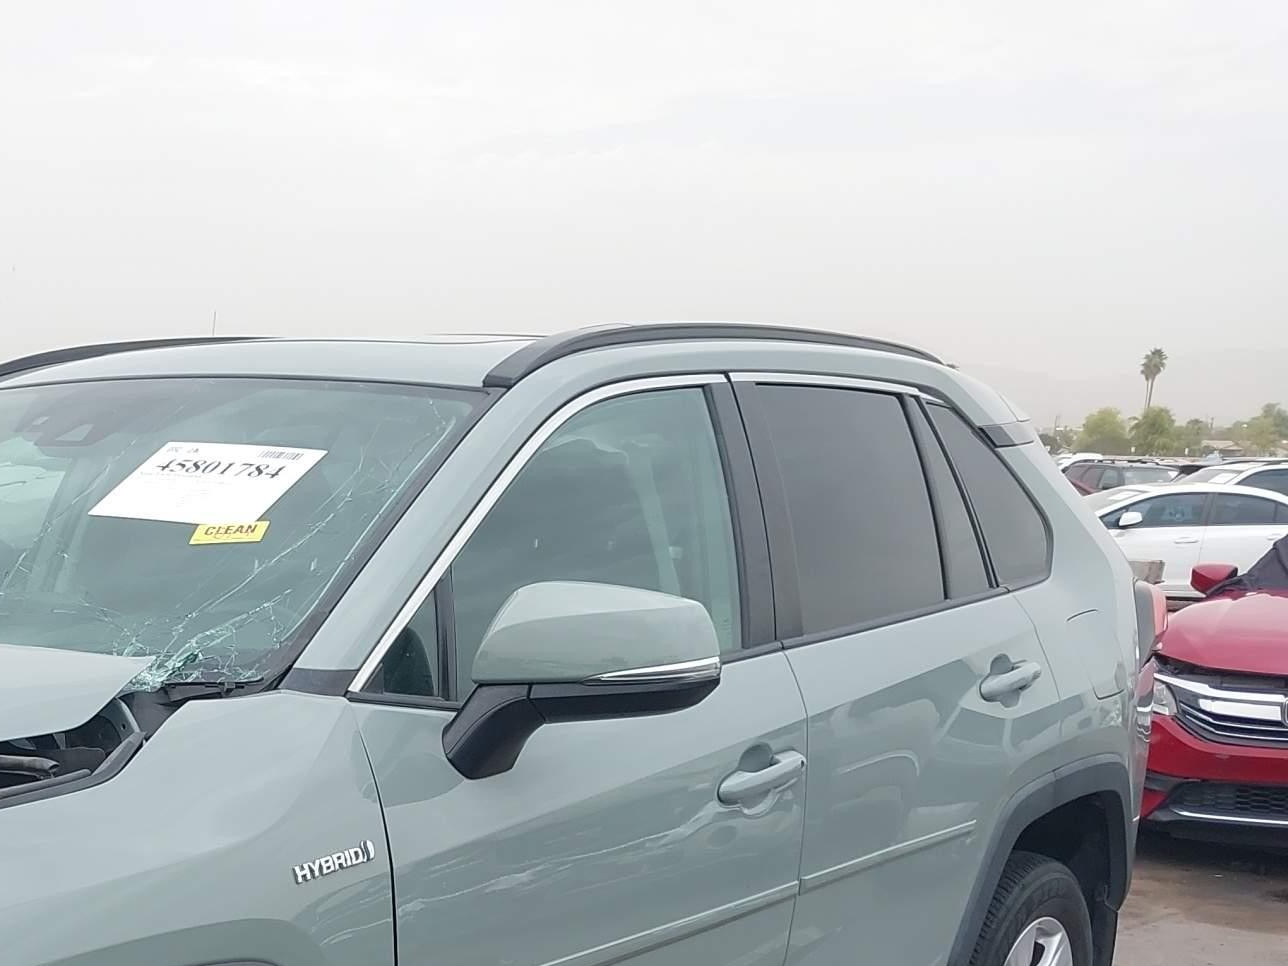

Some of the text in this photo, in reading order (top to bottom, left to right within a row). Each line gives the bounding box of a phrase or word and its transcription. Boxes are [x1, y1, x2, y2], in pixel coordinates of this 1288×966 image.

[155, 458, 287, 480] 45801784
[204, 524, 259, 536] CLEAN
[292, 846, 363, 885] HYBRID
